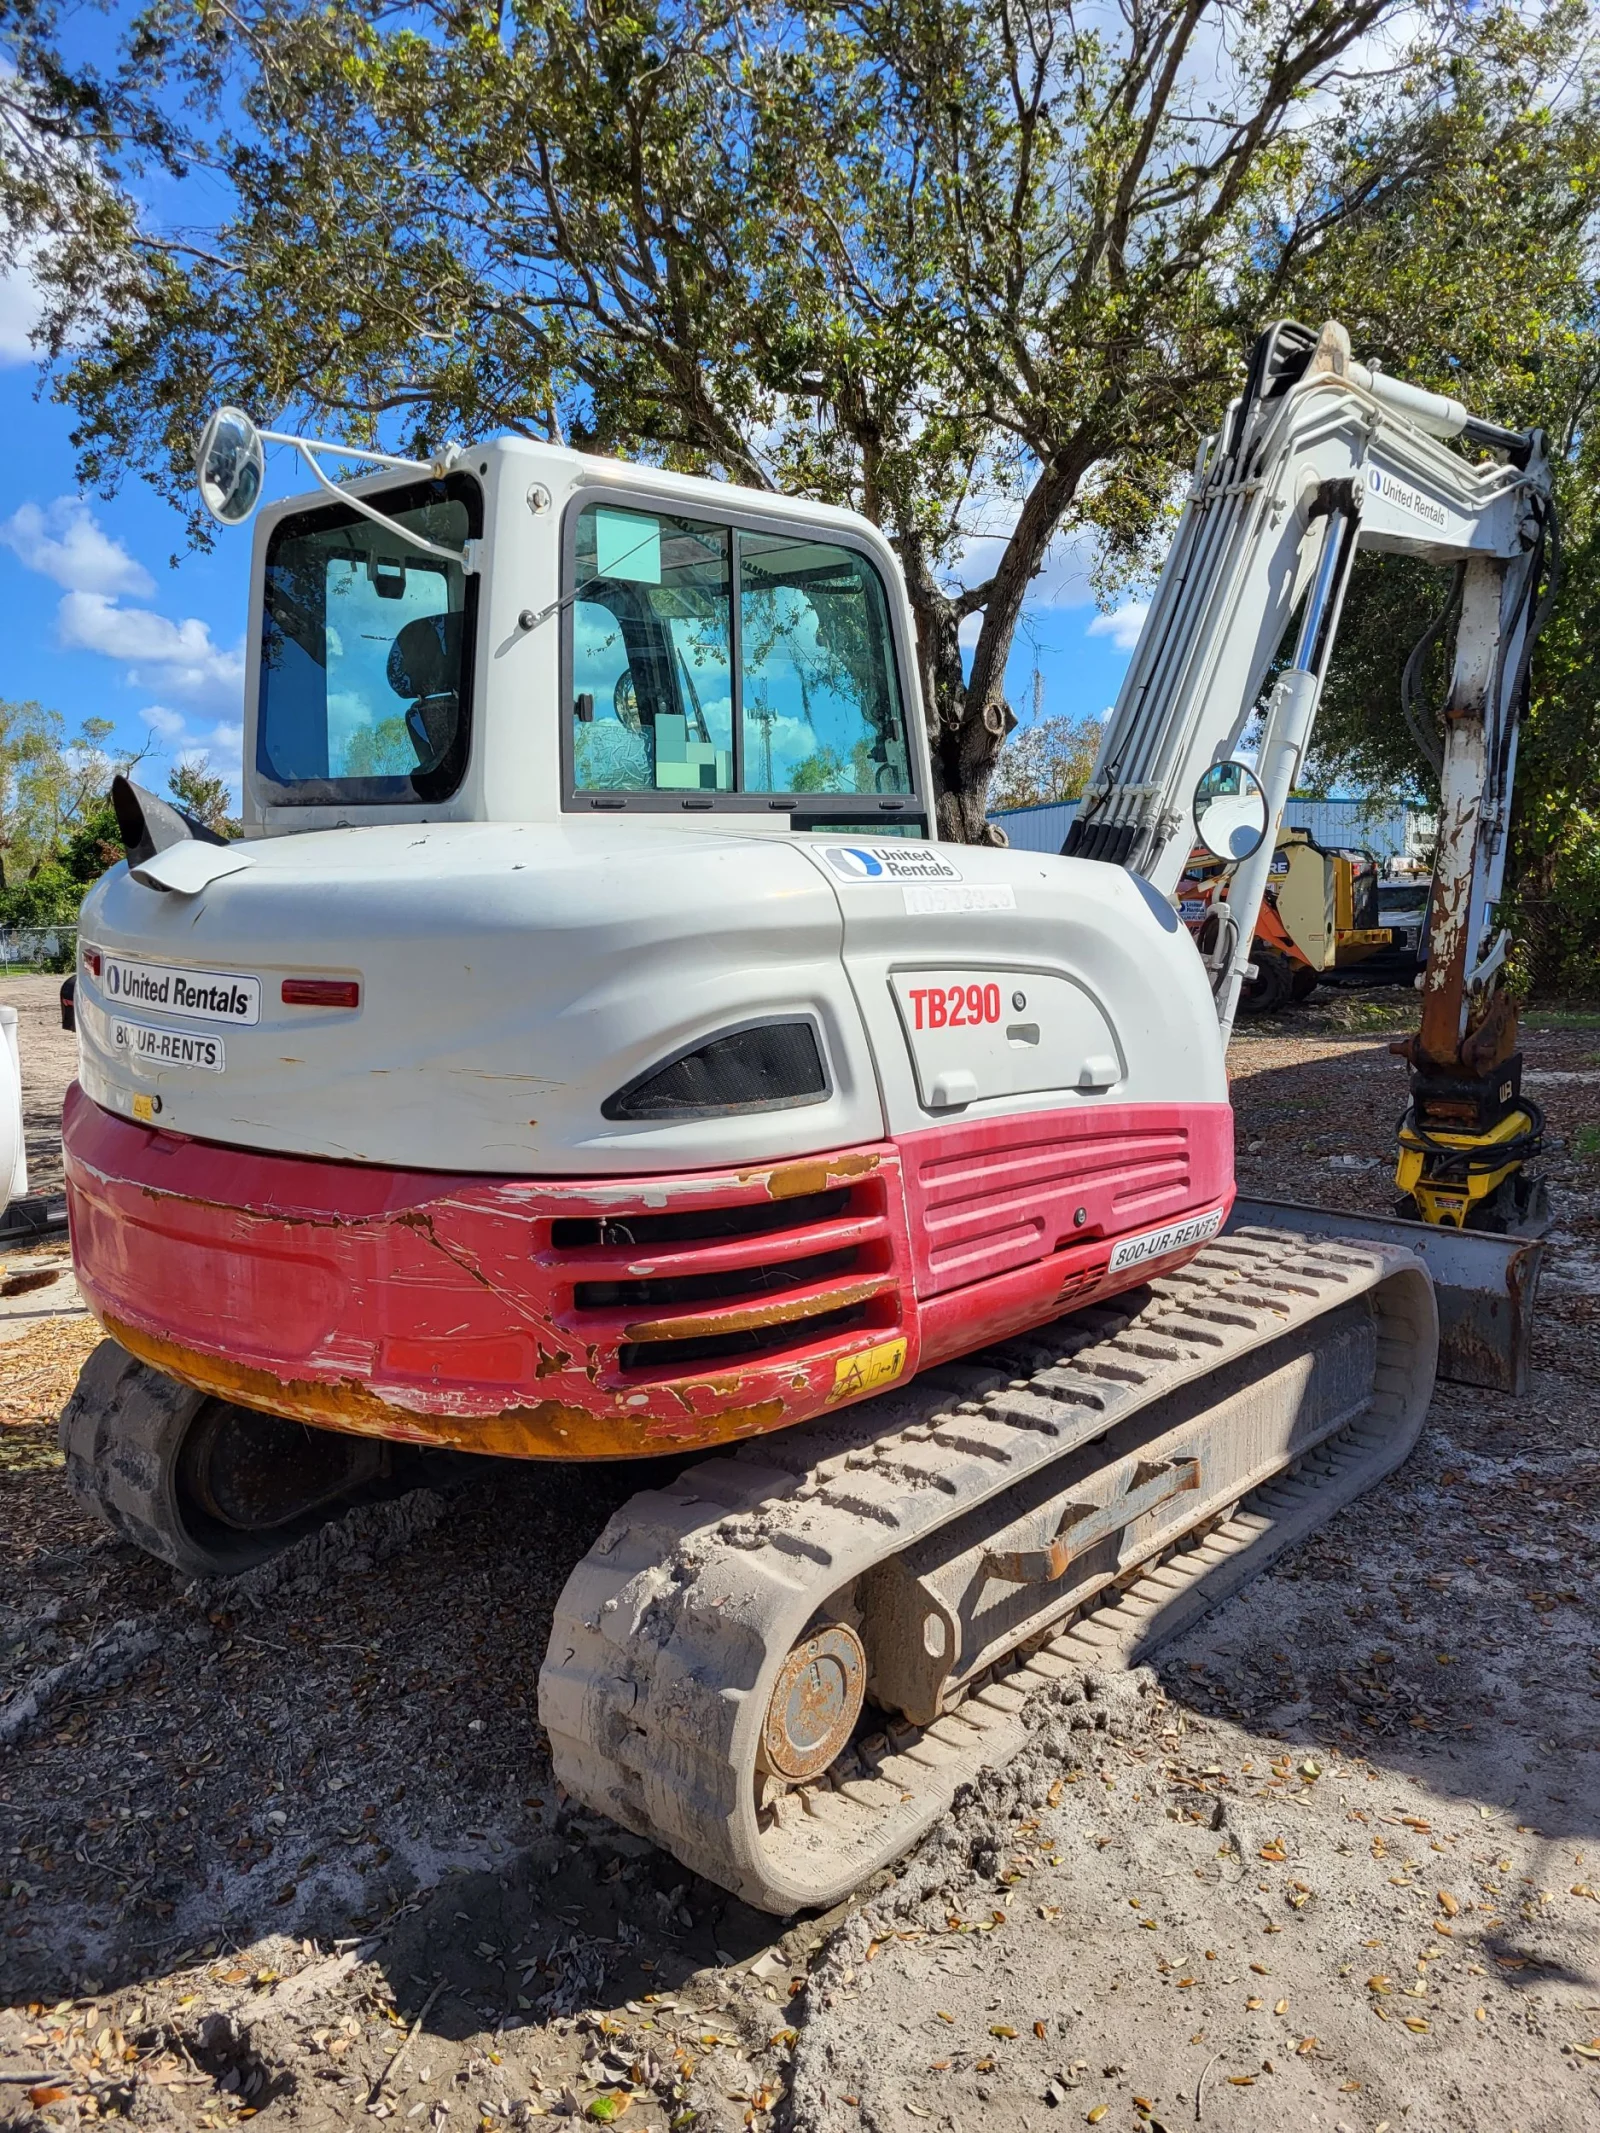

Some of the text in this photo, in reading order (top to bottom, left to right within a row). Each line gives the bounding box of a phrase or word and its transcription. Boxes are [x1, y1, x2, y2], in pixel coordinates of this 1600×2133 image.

[1382, 476, 1445, 526] United Rentals
[872, 849, 935, 862] United
[886, 861, 954, 877] Rentals
[123, 970, 249, 1015] United Rentals
[909, 983, 1001, 1030] TB290
[115, 1025, 217, 1065] 80-UR-RENTS
[1115, 1215, 1220, 1266] 800-UR-RENTS
